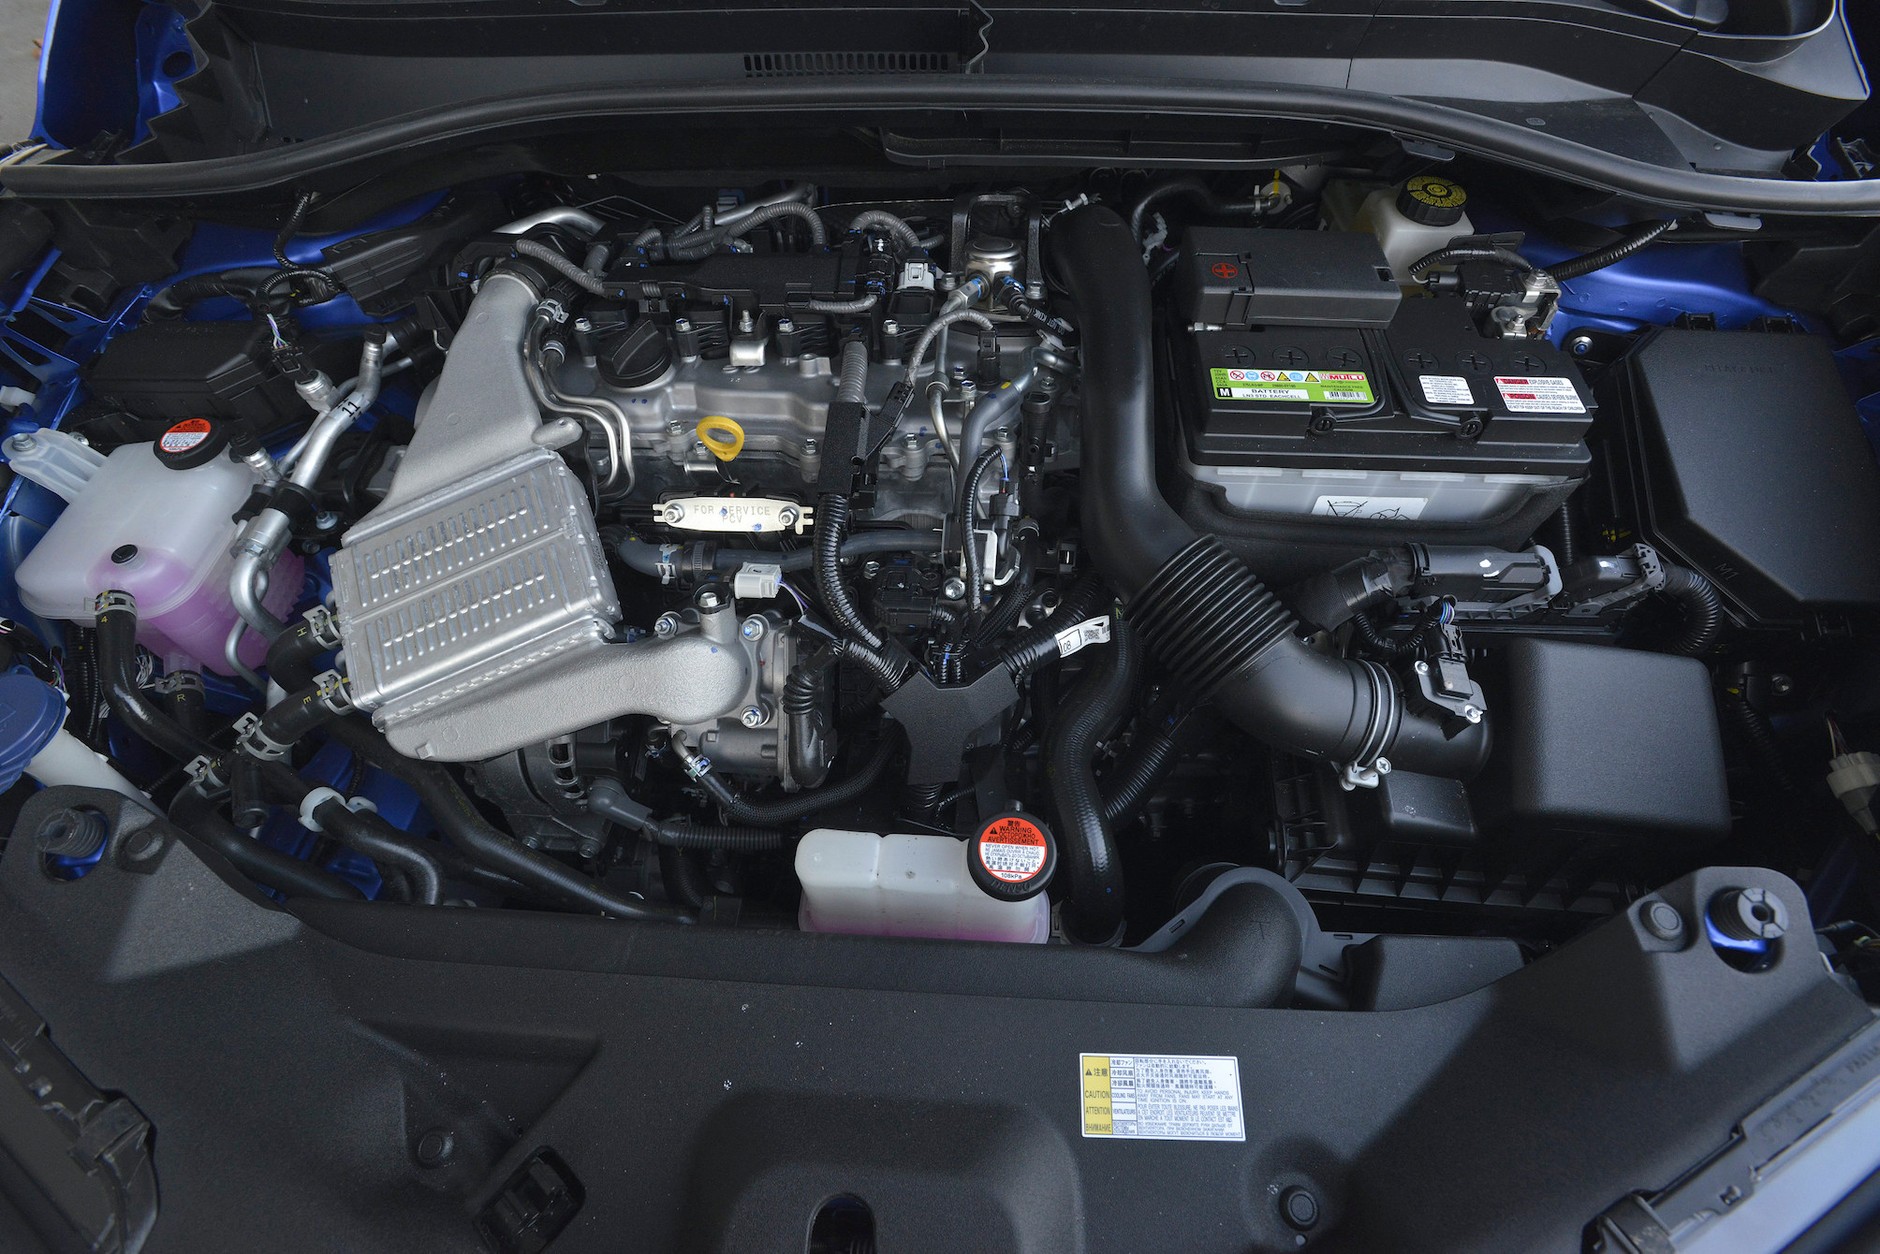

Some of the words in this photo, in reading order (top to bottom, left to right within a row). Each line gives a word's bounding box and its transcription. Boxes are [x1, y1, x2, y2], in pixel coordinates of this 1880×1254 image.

[1220, 388, 1230, 396] M
[342, 401, 361, 418] 11
[694, 504, 714, 514] FOR
[721, 505, 770, 516] SERVICE
[722, 515, 742, 524] PCV
[988, 836, 1039, 845] AVERTISSEMENT
[1094, 1068, 1108, 1077] 注意
[1085, 1090, 1110, 1098] CAUTION
[1085, 1124, 1111, 1132] ВНИМАНИЕ
